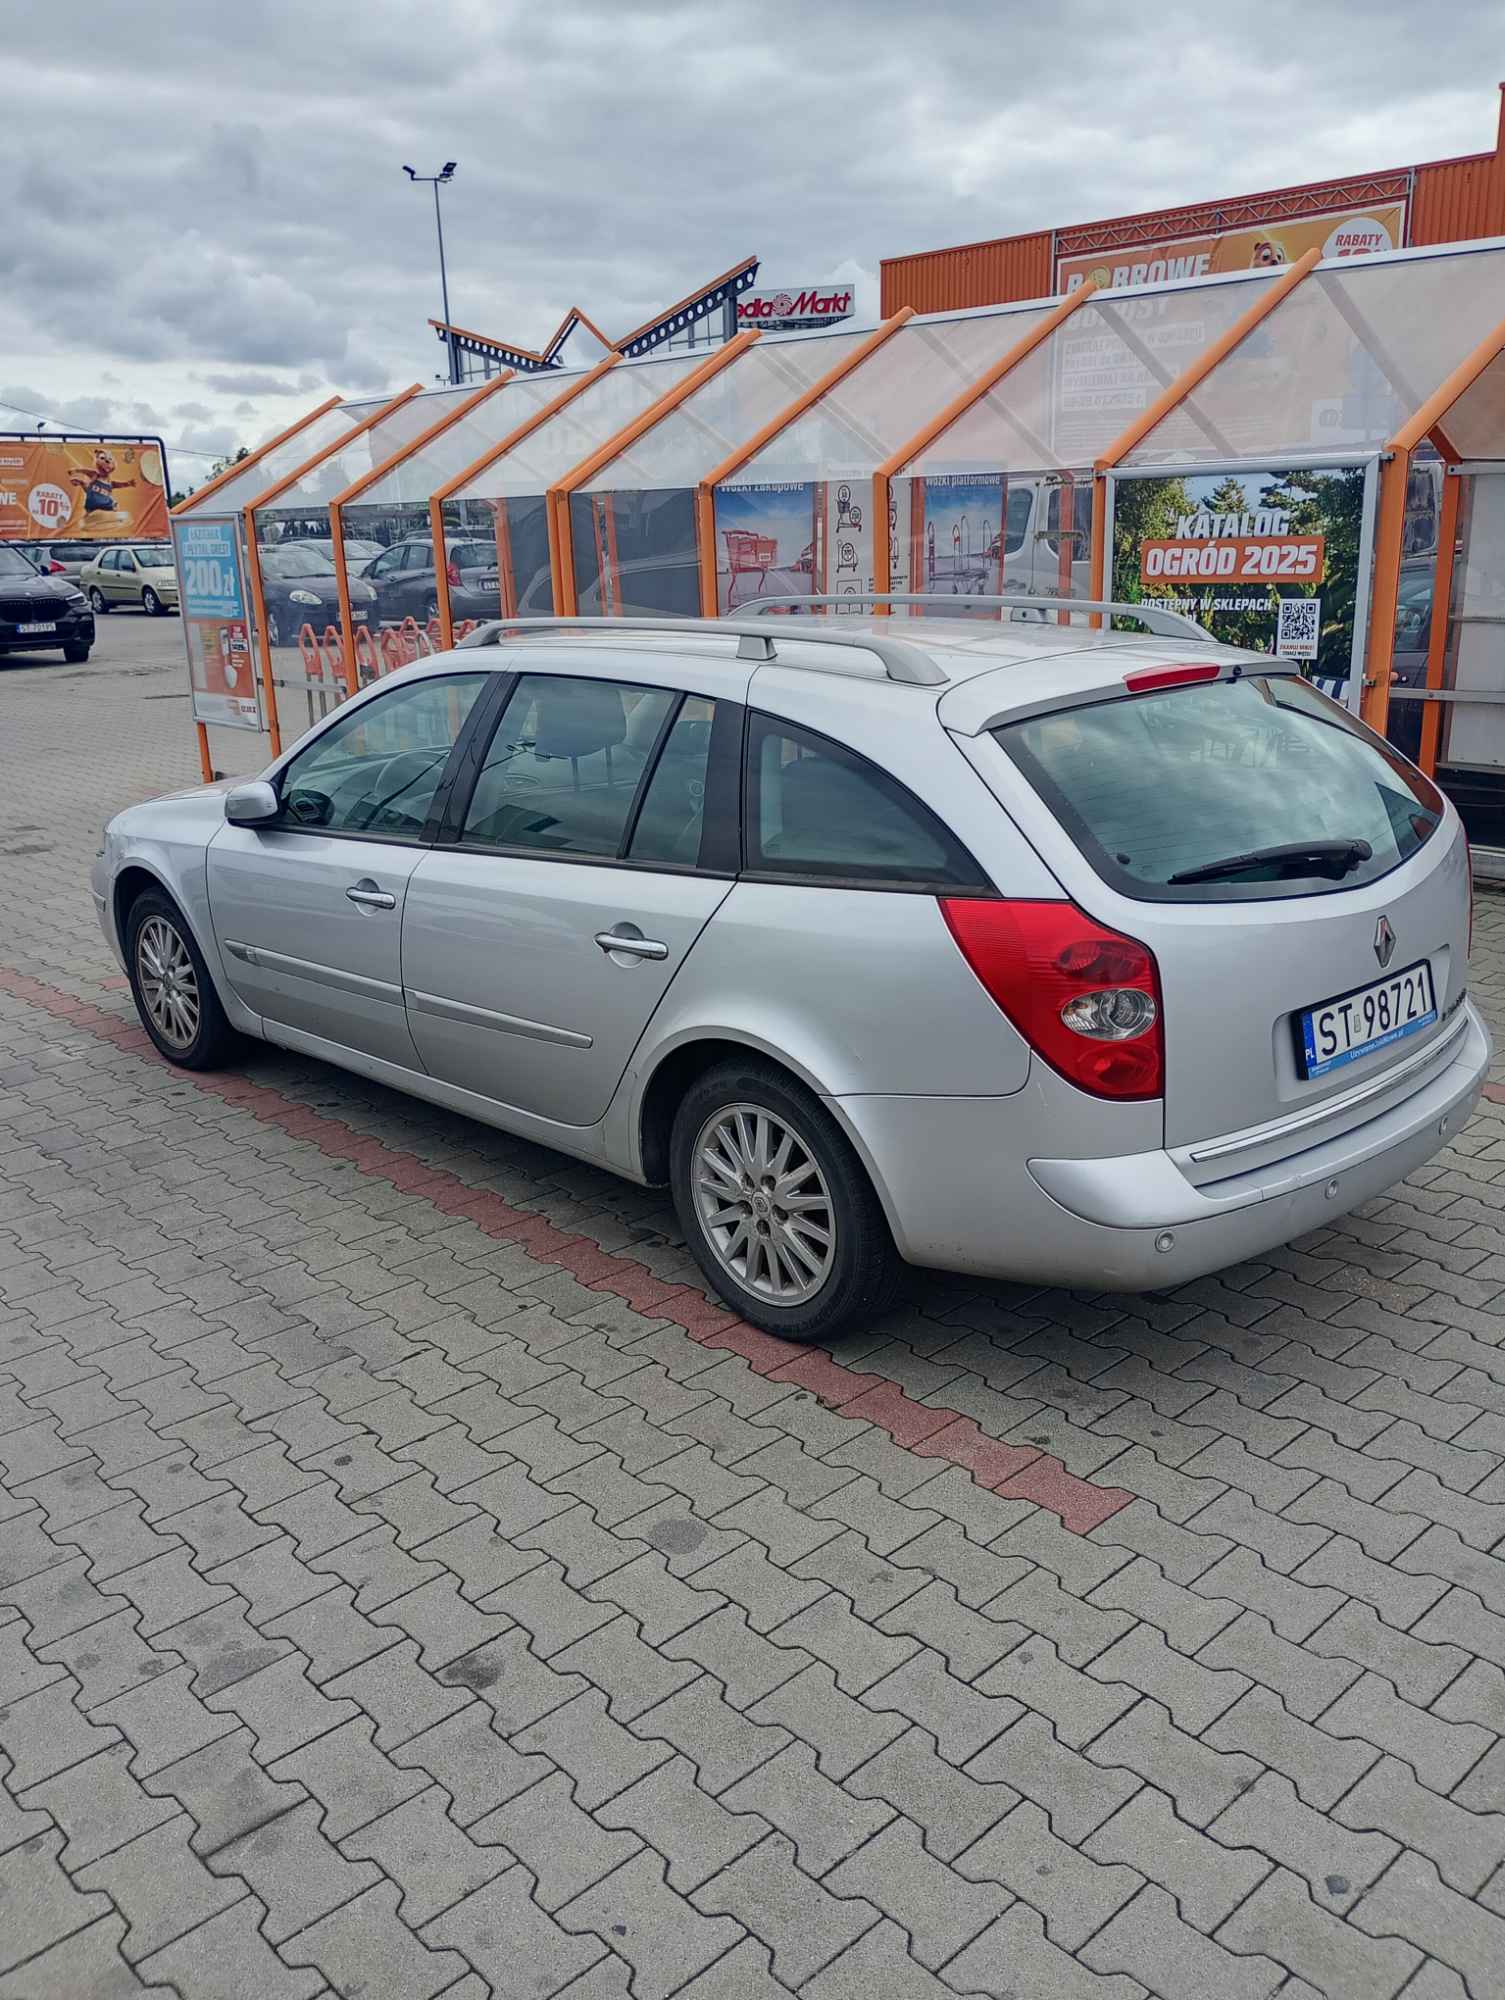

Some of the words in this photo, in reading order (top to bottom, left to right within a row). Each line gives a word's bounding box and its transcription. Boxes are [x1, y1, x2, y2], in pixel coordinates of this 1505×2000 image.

[1335, 232, 1384, 248] RABATY
[787, 290, 852, 316] Markt
[1176, 511, 1291, 539] KATALOG
[1145, 541, 1237, 577] OGRÓD
[1241, 544, 1318, 575] 2025
[184, 560, 223, 596] 200
[1199, 598, 1212, 611] W
[1213, 598, 1273, 611] SKLEPACH
[1319, 1003, 1353, 1056] ST
[1363, 971, 1428, 1040] 98721
[1304, 1047, 1316, 1060] PL
